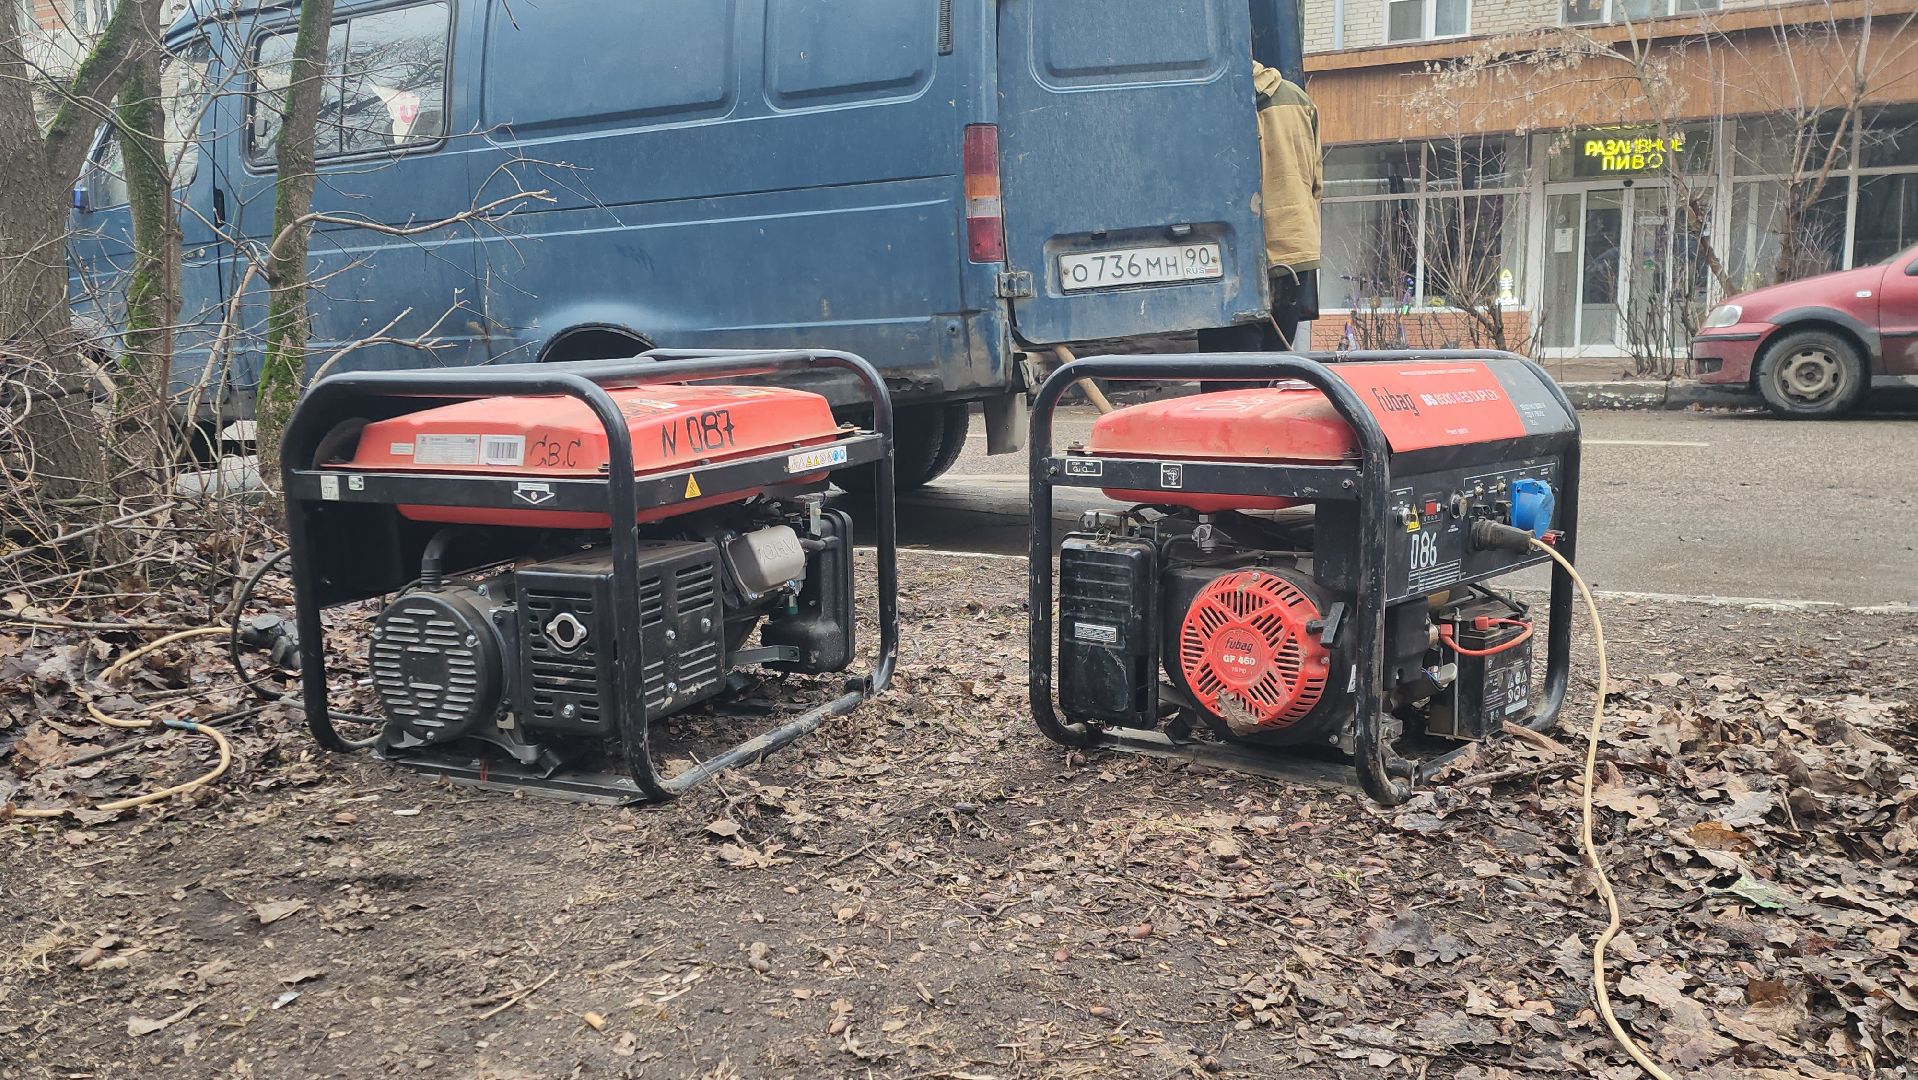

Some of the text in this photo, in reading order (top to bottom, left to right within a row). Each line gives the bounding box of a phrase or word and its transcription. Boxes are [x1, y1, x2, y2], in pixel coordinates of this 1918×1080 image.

[1602, 153, 1664, 170] ПИВО
[1185, 247, 1210, 266] 90
[1186, 267, 1205, 275] RUS
[686, 409, 735, 454] 087
[763, 539, 796, 560] OHV
[1411, 531, 1437, 569] 086
[1222, 654, 1256, 666] GF 460
